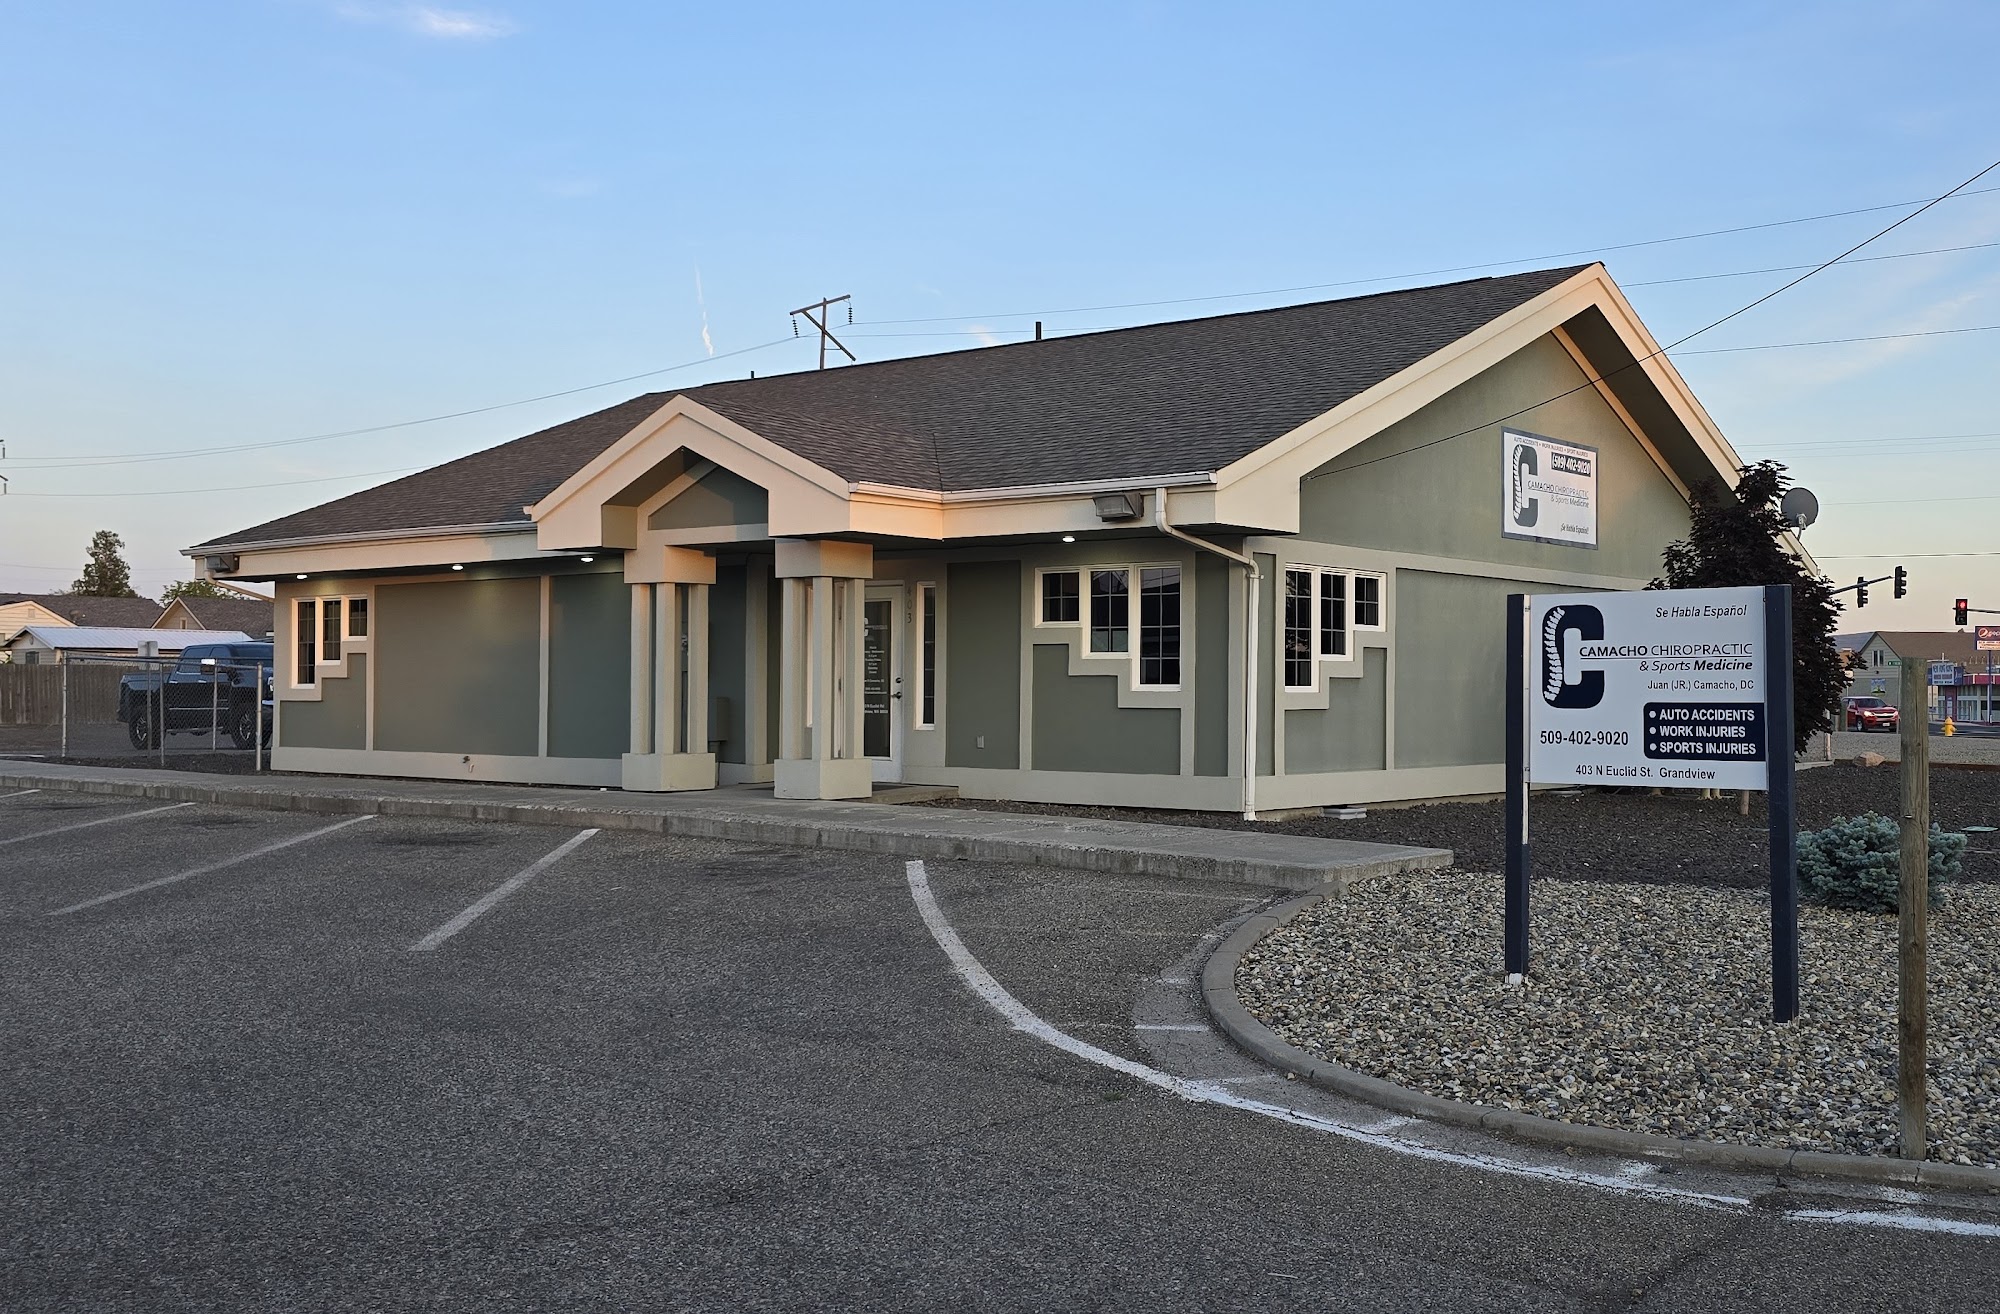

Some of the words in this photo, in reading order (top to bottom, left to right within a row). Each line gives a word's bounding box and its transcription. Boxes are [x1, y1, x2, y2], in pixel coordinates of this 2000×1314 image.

[1552, 454, 1566, 470] (509)
[1566, 457, 1591, 475] 402-9020
[1528, 480, 1554, 492] CAMACHO
[1555, 485, 1589, 498] CHIROPRACTIC
[1555, 496, 1569, 505] Sports
[1570, 498, 1589, 508] Medicine
[1655, 607, 1669, 618] Se
[1671, 606, 1700, 618] Habla
[1703, 605, 1747, 619] Español
[1579, 645, 1648, 657] CAMACHO
[1651, 643, 1753, 656] CHIROPRACTIC
[1639, 661, 1649, 671] &
[1651, 661, 1691, 673] Sports
[1694, 659, 1753, 671] Medicine
[1647, 680, 1669, 690] Juan
[1671, 680, 1691, 691] (JR.)
[1693, 680, 1738, 691] Camacho,
[1740, 680, 1754, 690] DC
[1659, 709, 1690, 721] AUTO
[1691, 709, 1755, 721] ACCIDENTS
[1540, 730, 1629, 746] 509-402-9020
[1659, 726, 1693, 738] WORK
[1695, 726, 1746, 738] INJURIES
[1659, 742, 1703, 754] SPORTS
[1705, 743, 1757, 755] INJURIES
[1575, 765, 1593, 775] 403
[1595, 765, 1603, 776] N
[1606, 765, 1637, 777] Euclid
[1639, 767, 1654, 778] St.
[1659, 767, 1716, 780] Grandview
